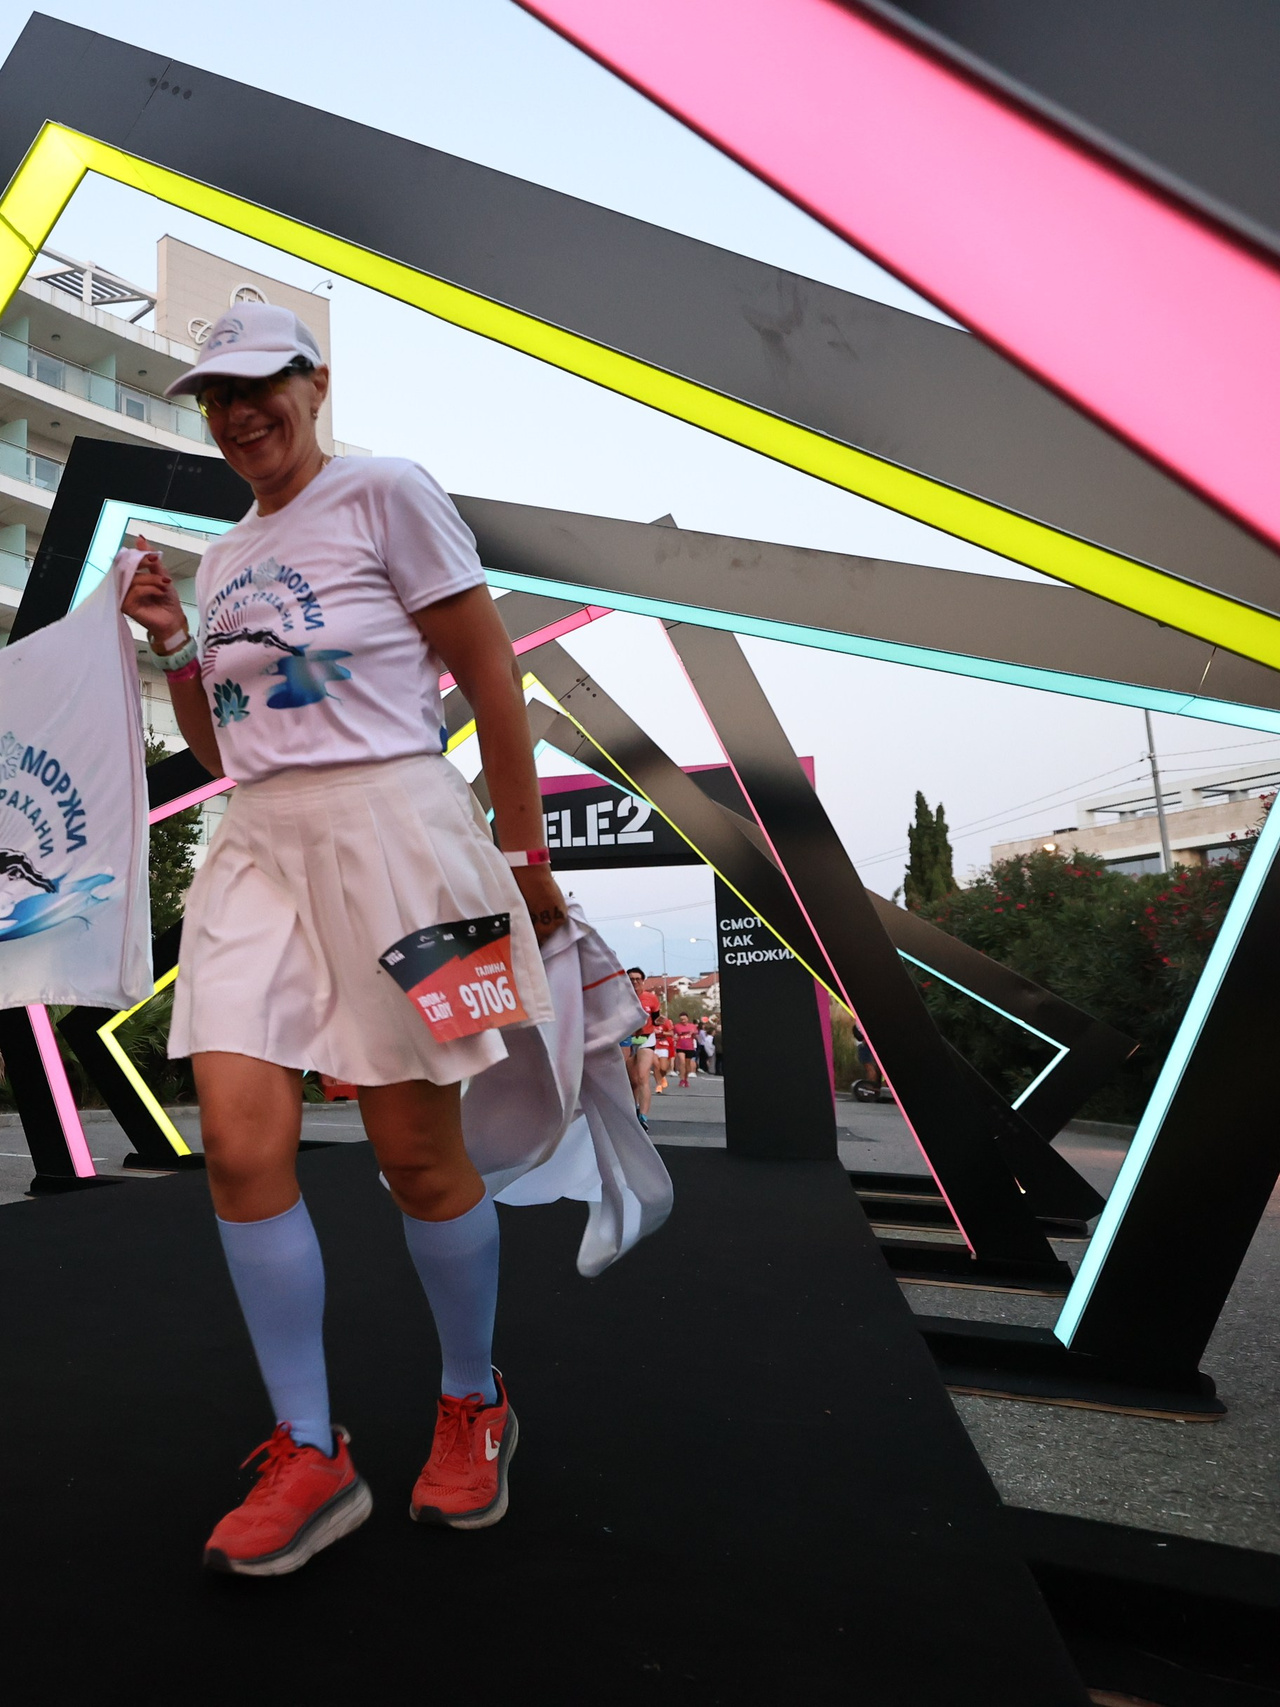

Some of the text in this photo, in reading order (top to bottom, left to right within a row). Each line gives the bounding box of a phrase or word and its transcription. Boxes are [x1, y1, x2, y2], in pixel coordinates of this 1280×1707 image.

[19, 746, 87, 854] МОРЖИ
[542, 795, 654, 849] ELE2
[720, 916, 763, 931] СМОТ
[722, 934, 754, 948] КАК
[474, 962, 506, 977] ГАЛИНА
[459, 976, 516, 1019] 9706
[424, 1002, 453, 1022] LADY
